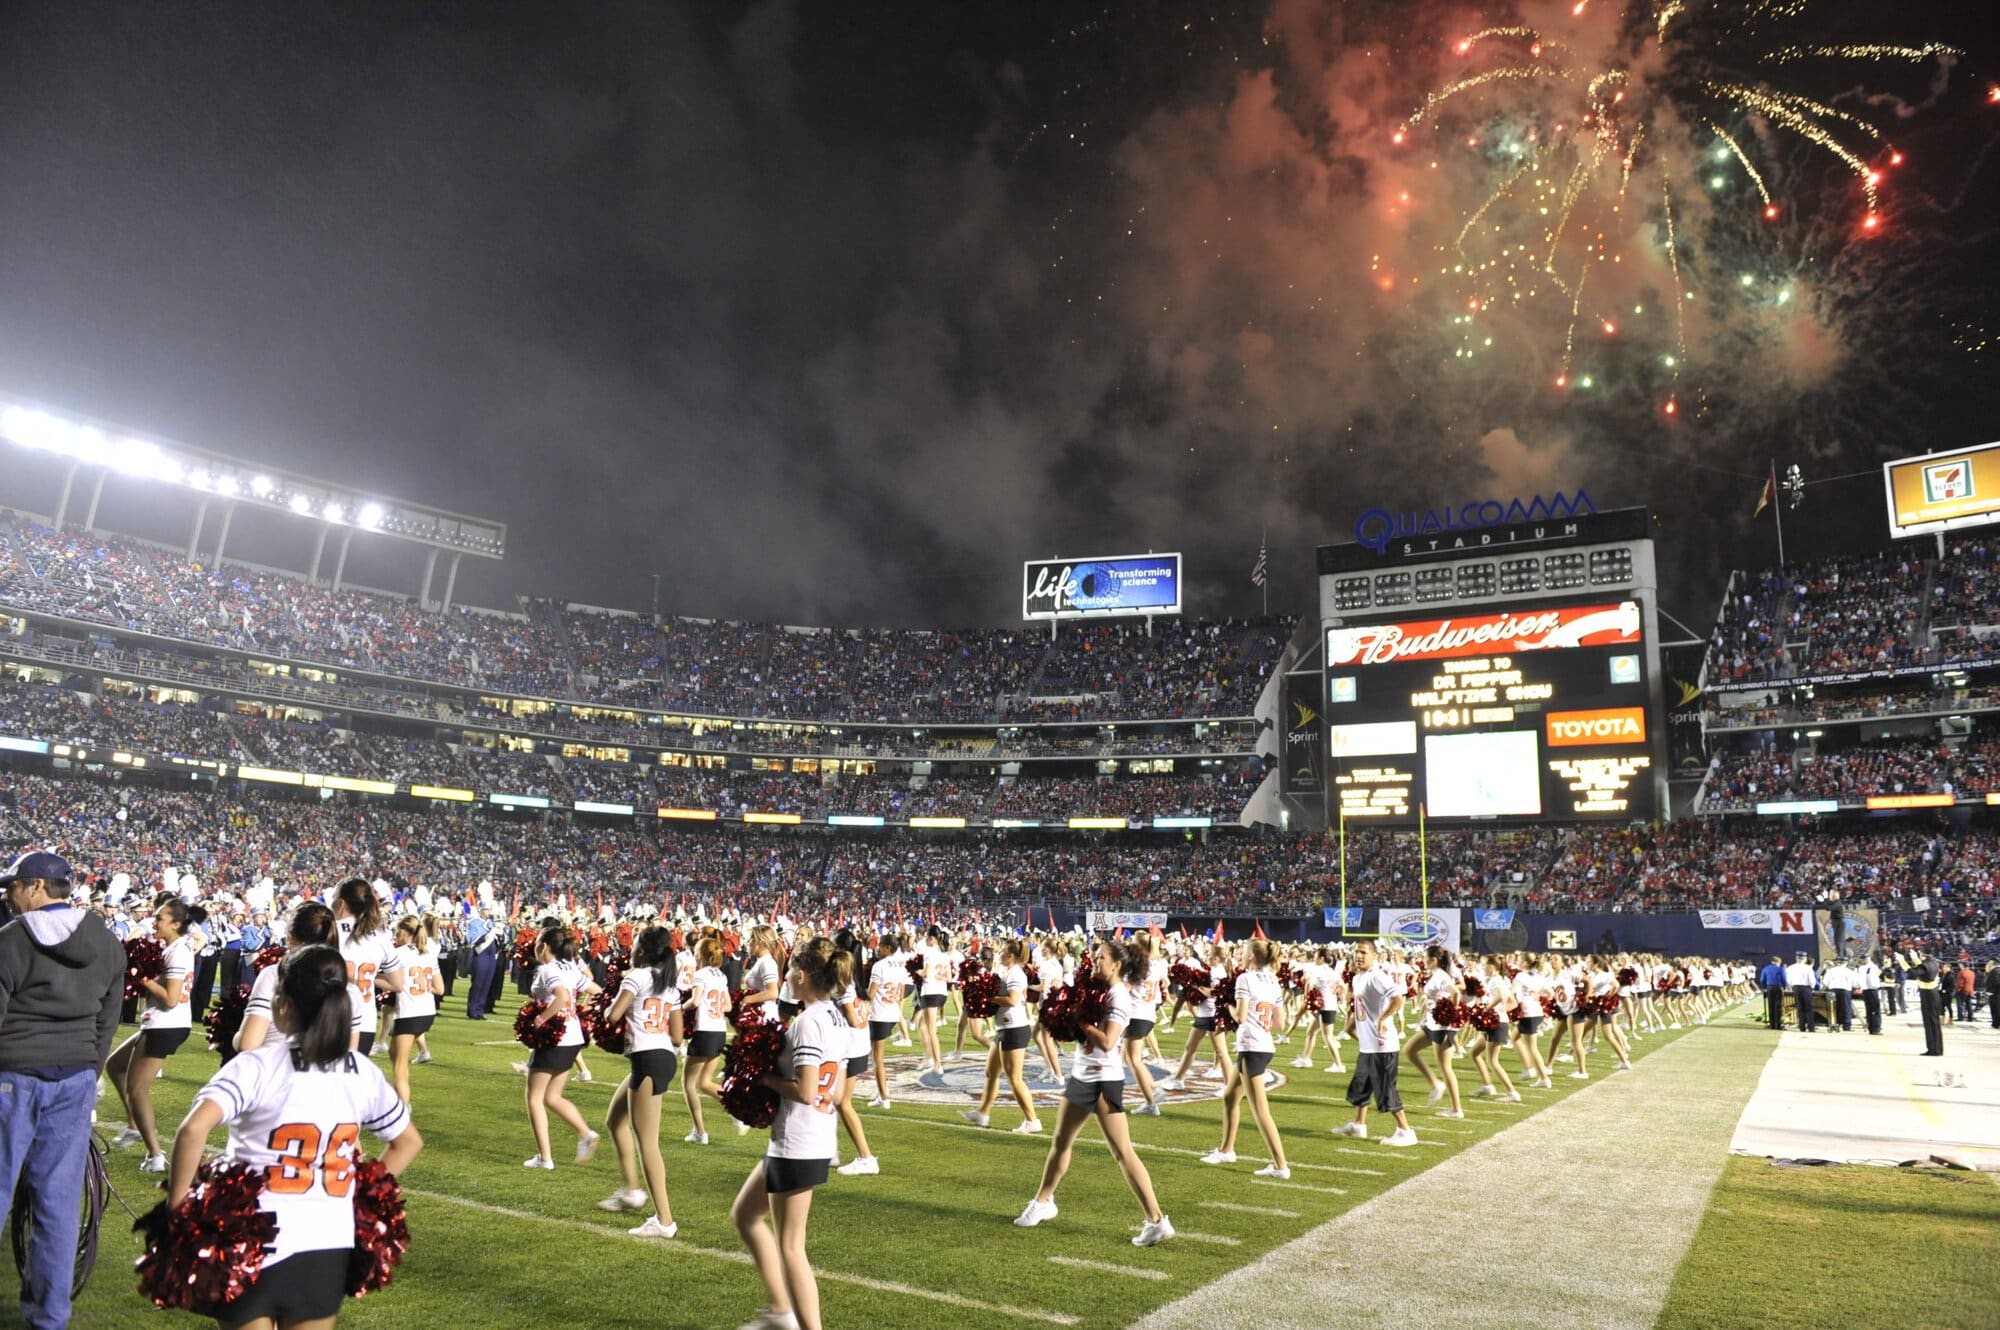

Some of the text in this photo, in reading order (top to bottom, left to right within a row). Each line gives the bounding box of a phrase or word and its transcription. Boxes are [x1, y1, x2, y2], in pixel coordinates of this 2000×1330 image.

[1934, 468, 1961, 498] 7
[1354, 488, 1597, 555] QUALCOMM
[1403, 523, 1578, 554] STADIUM
[1108, 567, 1172, 579] Transforming
[1122, 577, 1158, 587] science
[1028, 566, 1078, 610] life
[1357, 611, 1562, 664] Budweiser
[1493, 657, 1511, 670] TO
[1889, 666, 1925, 674] OCATION
[1461, 670, 1522, 687] PEPPER
[1411, 688, 1497, 706] HALFTIME
[1668, 710, 1702, 725] Sprin
[1551, 717, 1641, 738] TOYOTA
[1288, 731, 1319, 744] Sprint
[1092, 913, 1108, 929] A
[1779, 911, 1804, 932] N
[264, 1122, 360, 1197] 36
